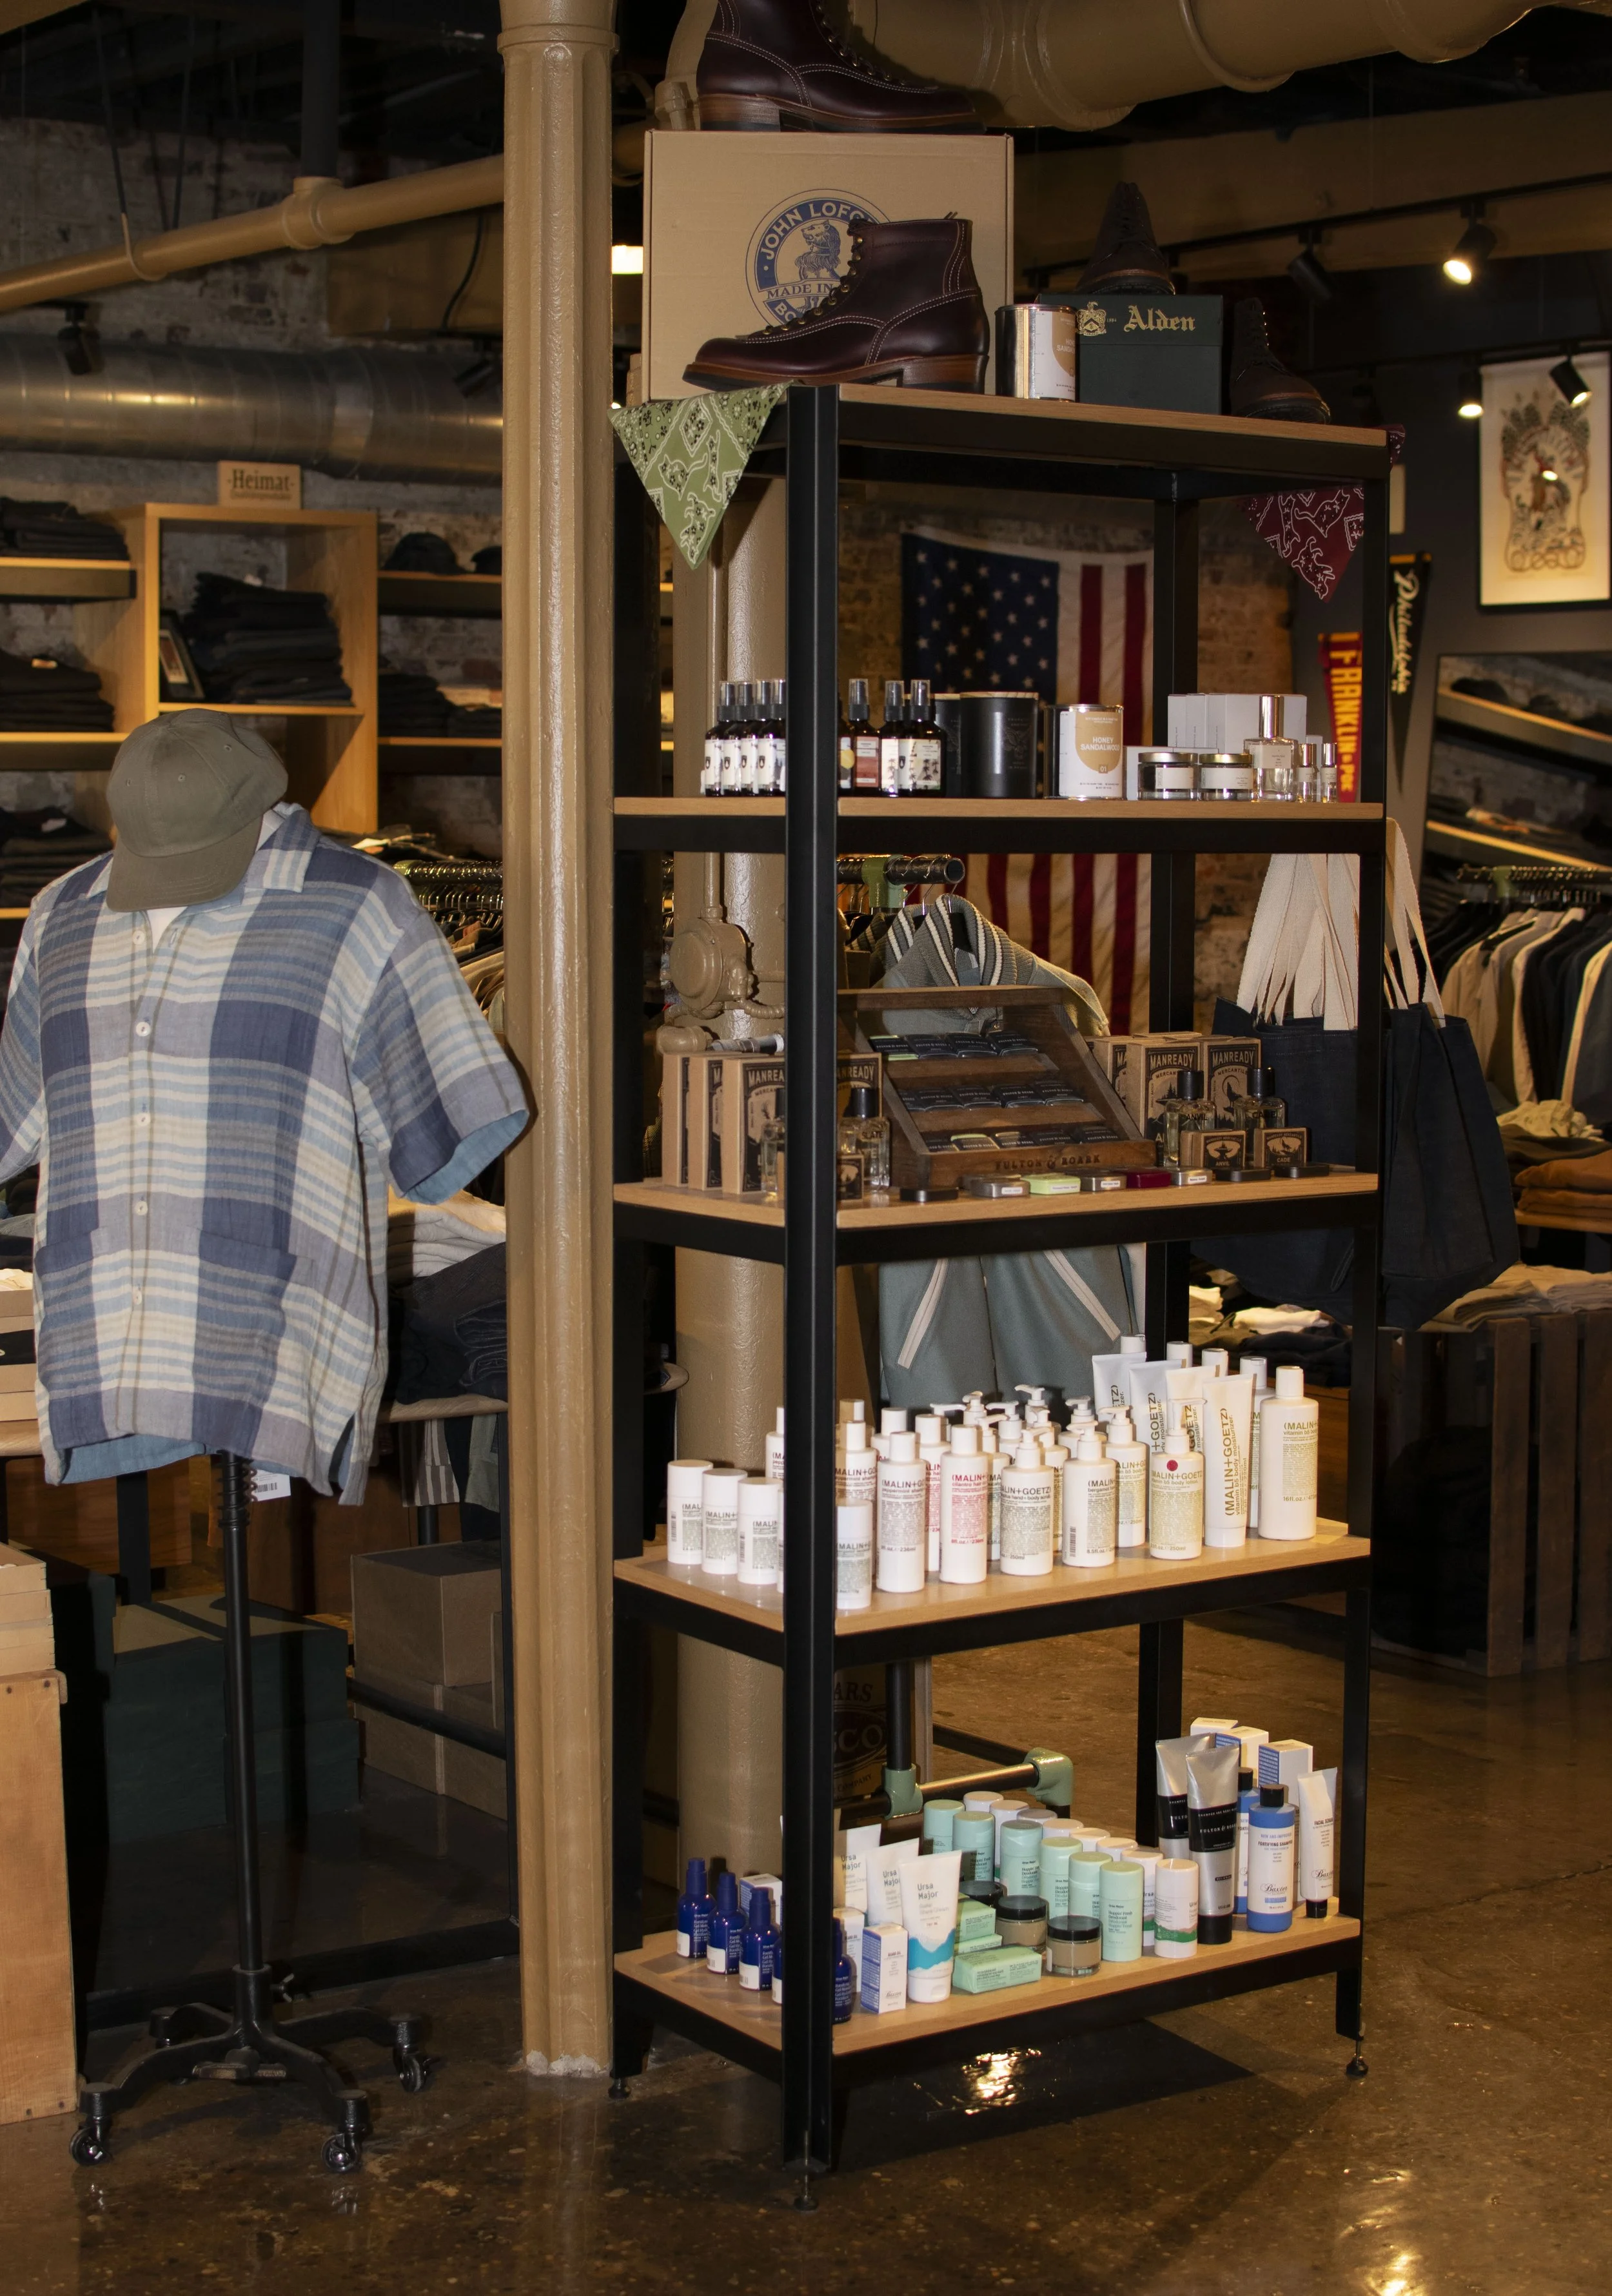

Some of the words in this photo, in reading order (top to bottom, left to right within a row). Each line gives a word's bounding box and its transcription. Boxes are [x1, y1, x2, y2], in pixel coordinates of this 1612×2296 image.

[760, 208, 803, 260] JOHN
[767, 284, 811, 299] MADE
[1123, 304, 1196, 333] Alden
[233, 468, 290, 491] Heimat
[1150, 1054, 1194, 1070] MANREADY
[1212, 1051, 1255, 1066] MANREADY
[996, 1161, 1041, 1170] FULTON
[1061, 1155, 1101, 1166] ROARK
[1229, 1415, 1237, 1456] moisturizer.
[1220, 1408, 1235, 1516] (MALIN+GOETZ)
[1234, 1478, 1239, 1487] b5
[842, 1862, 861, 1870] Major
[918, 1883, 934, 1891] Ursa
[1260, 1883, 1288, 1892] Baxter
[918, 1890, 938, 1900] Major
